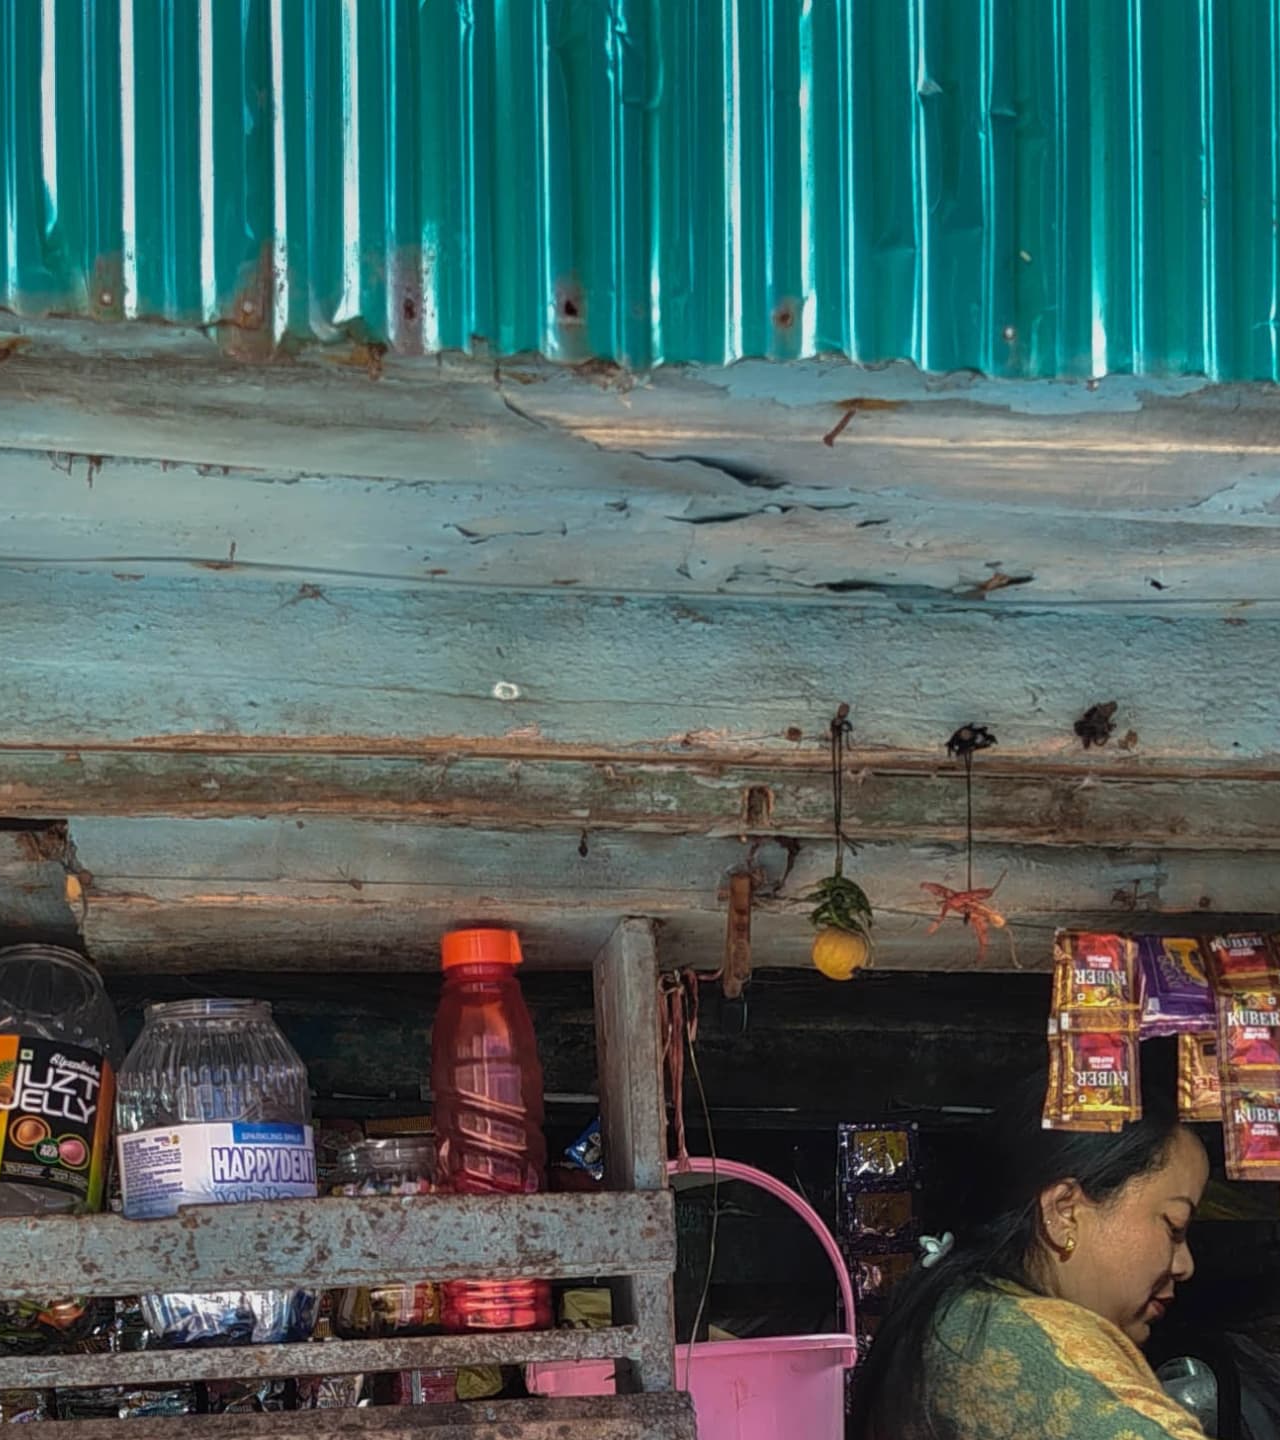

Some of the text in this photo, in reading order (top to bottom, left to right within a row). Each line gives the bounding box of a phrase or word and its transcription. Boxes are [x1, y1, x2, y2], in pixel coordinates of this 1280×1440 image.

[1076, 969, 1128, 986] KUBER
[1077, 1070, 1129, 1087] KUBER
[211, 1147, 317, 1184] HAPPYDENT
